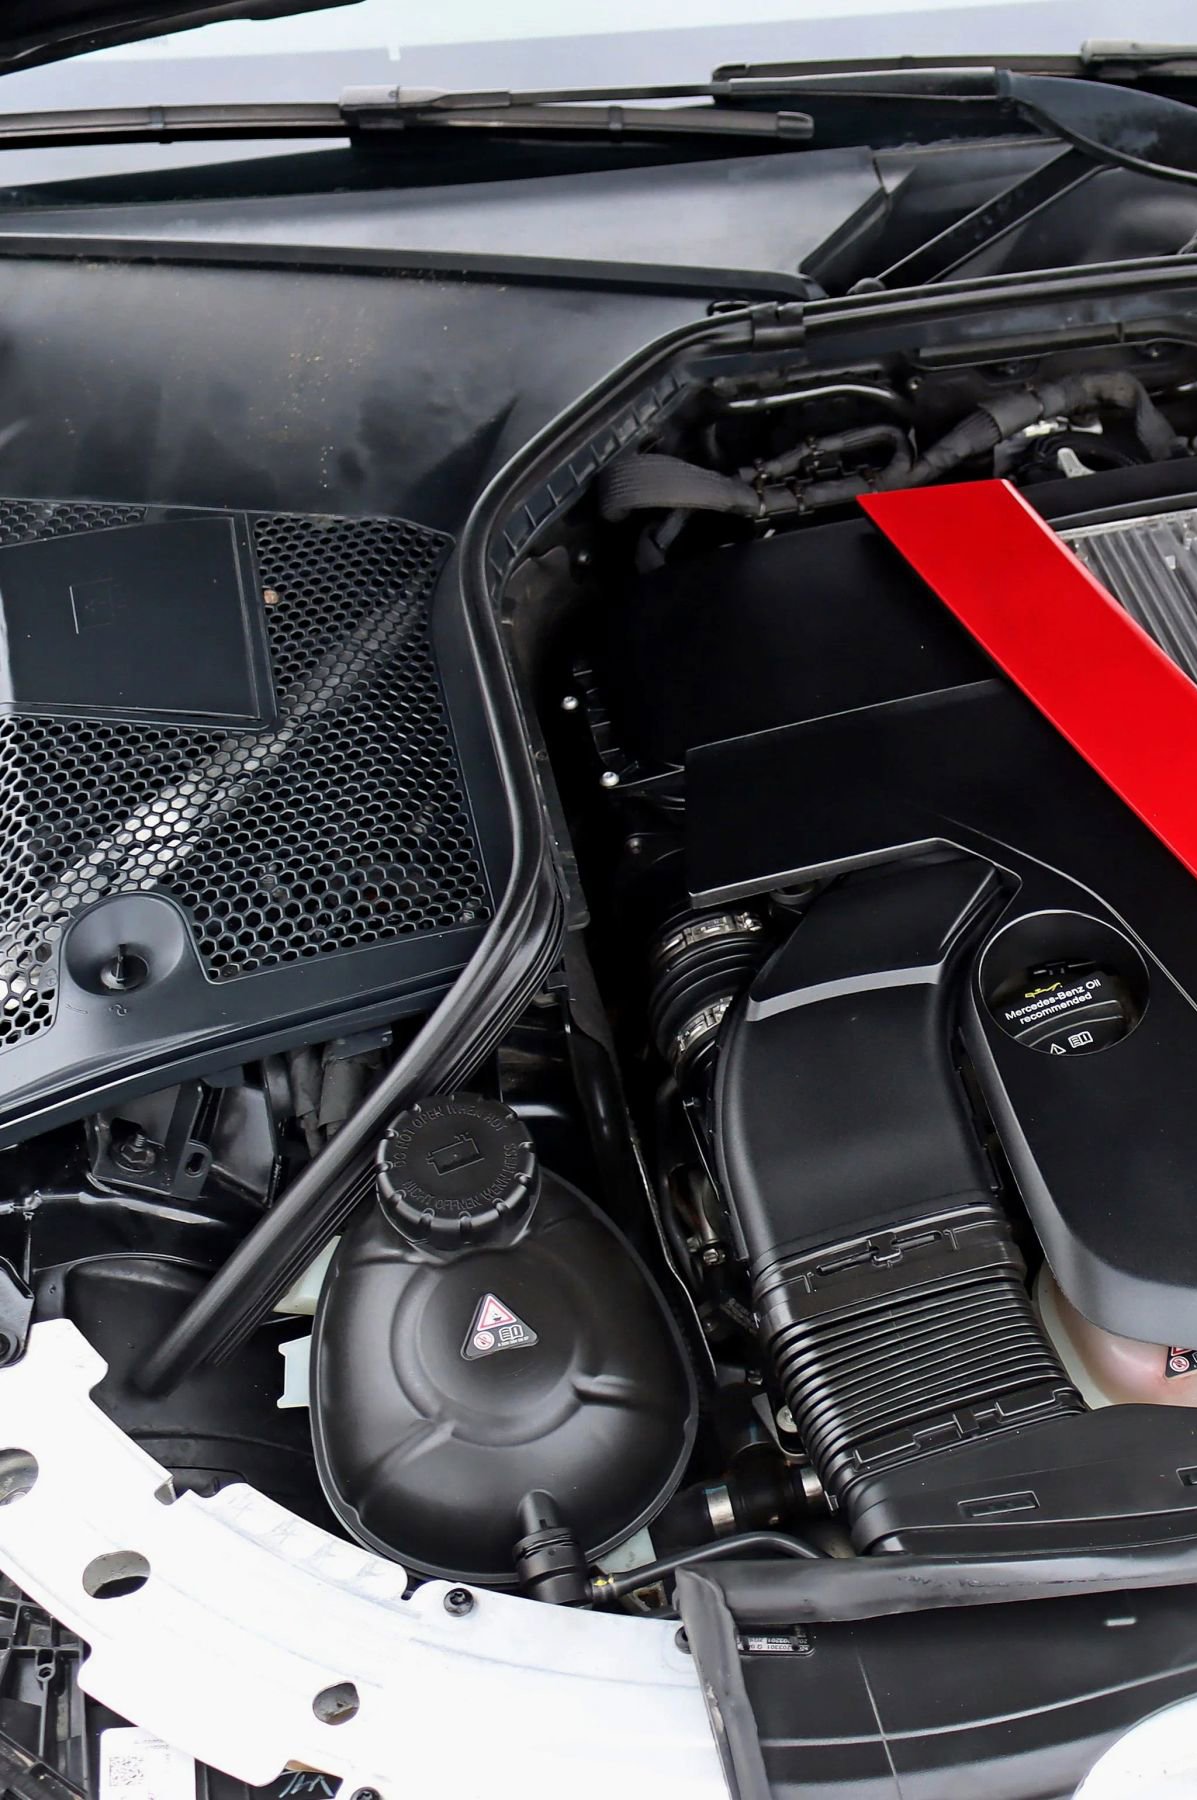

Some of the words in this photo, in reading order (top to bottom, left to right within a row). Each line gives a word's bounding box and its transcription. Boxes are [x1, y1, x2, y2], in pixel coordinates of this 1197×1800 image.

[1004, 984, 1086, 1021] Mercedes-Benz
[1085, 978, 1102, 990] Oil
[1019, 991, 1093, 1025] recommended
[395, 1126, 416, 1150] NOT
[411, 1106, 445, 1129] OPEN
